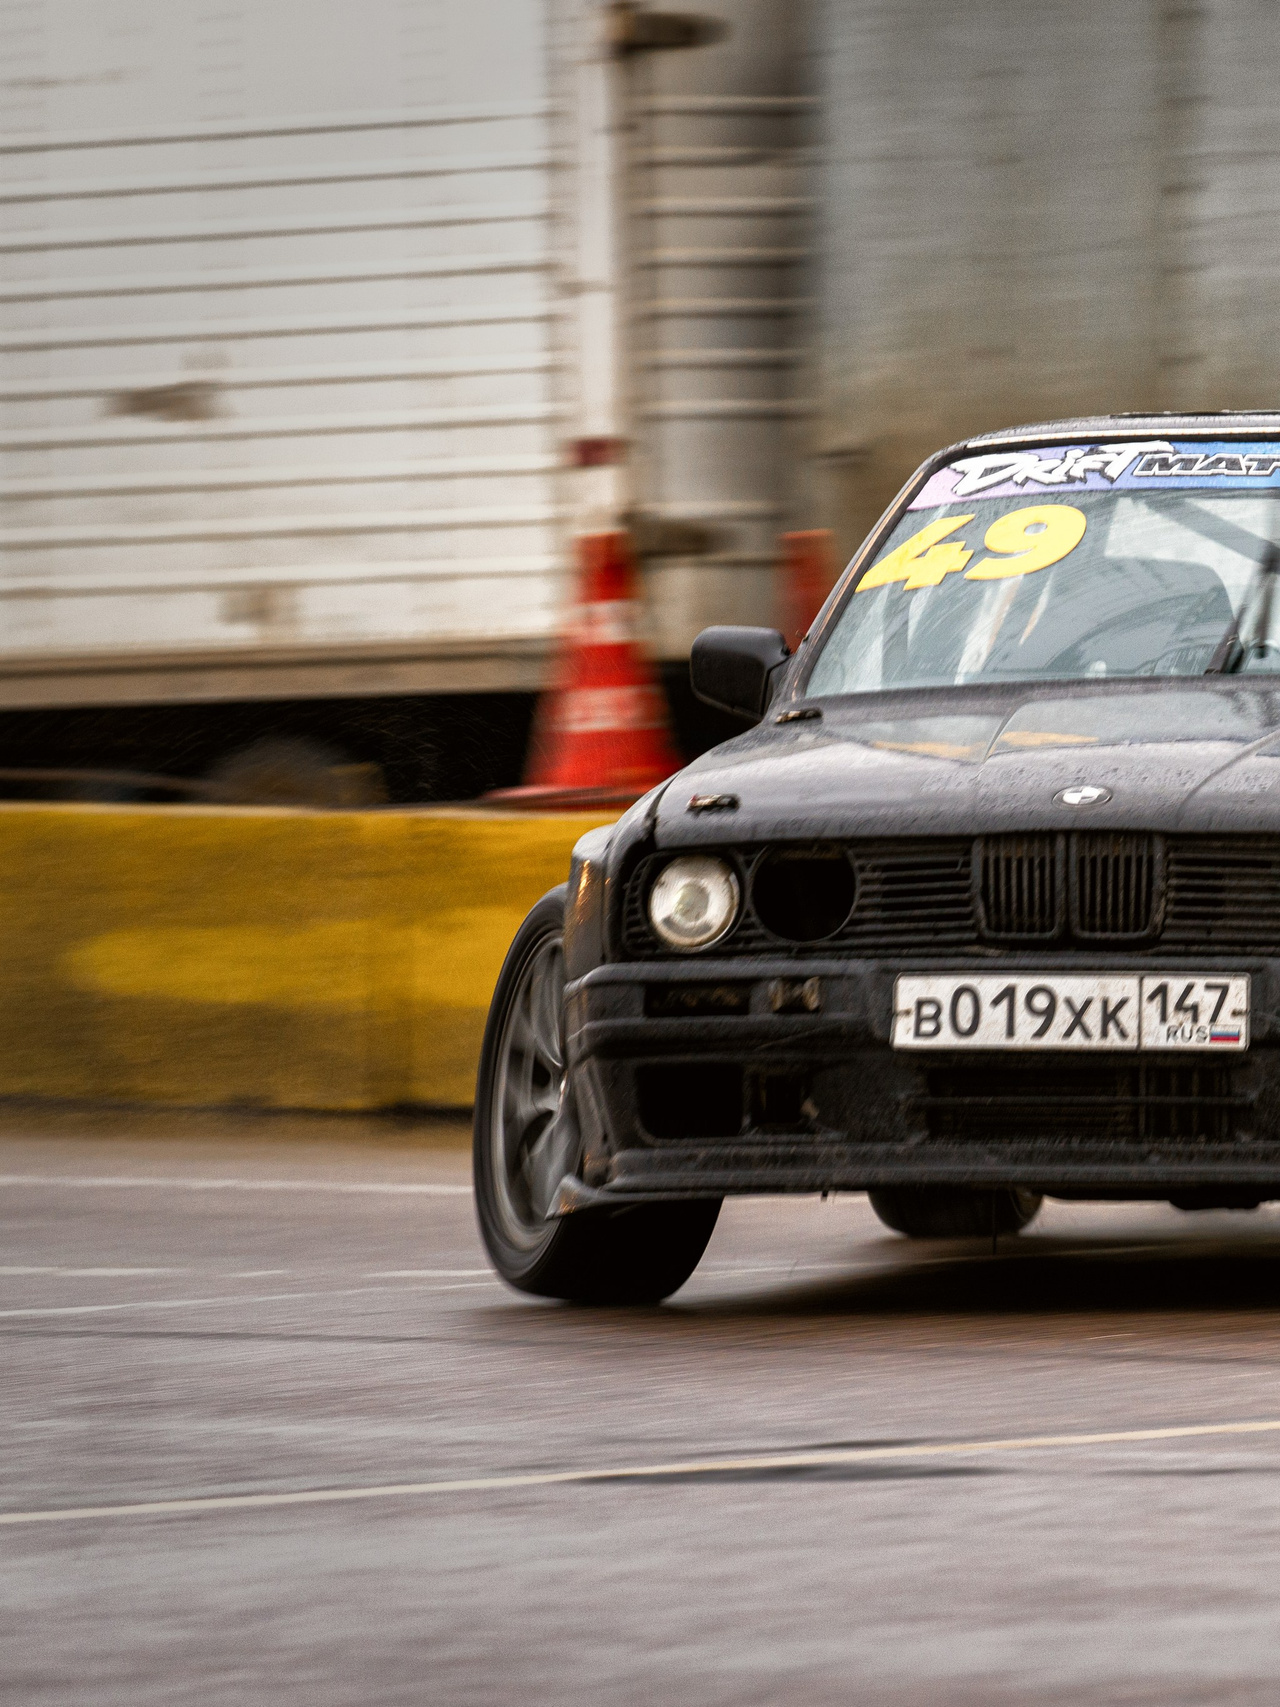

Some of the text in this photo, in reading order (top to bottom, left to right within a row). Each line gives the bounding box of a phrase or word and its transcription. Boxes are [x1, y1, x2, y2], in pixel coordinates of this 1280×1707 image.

[855, 504, 1087, 593] 49
[1146, 981, 1230, 1024] 147
[1166, 1024, 1208, 1044] RUS
